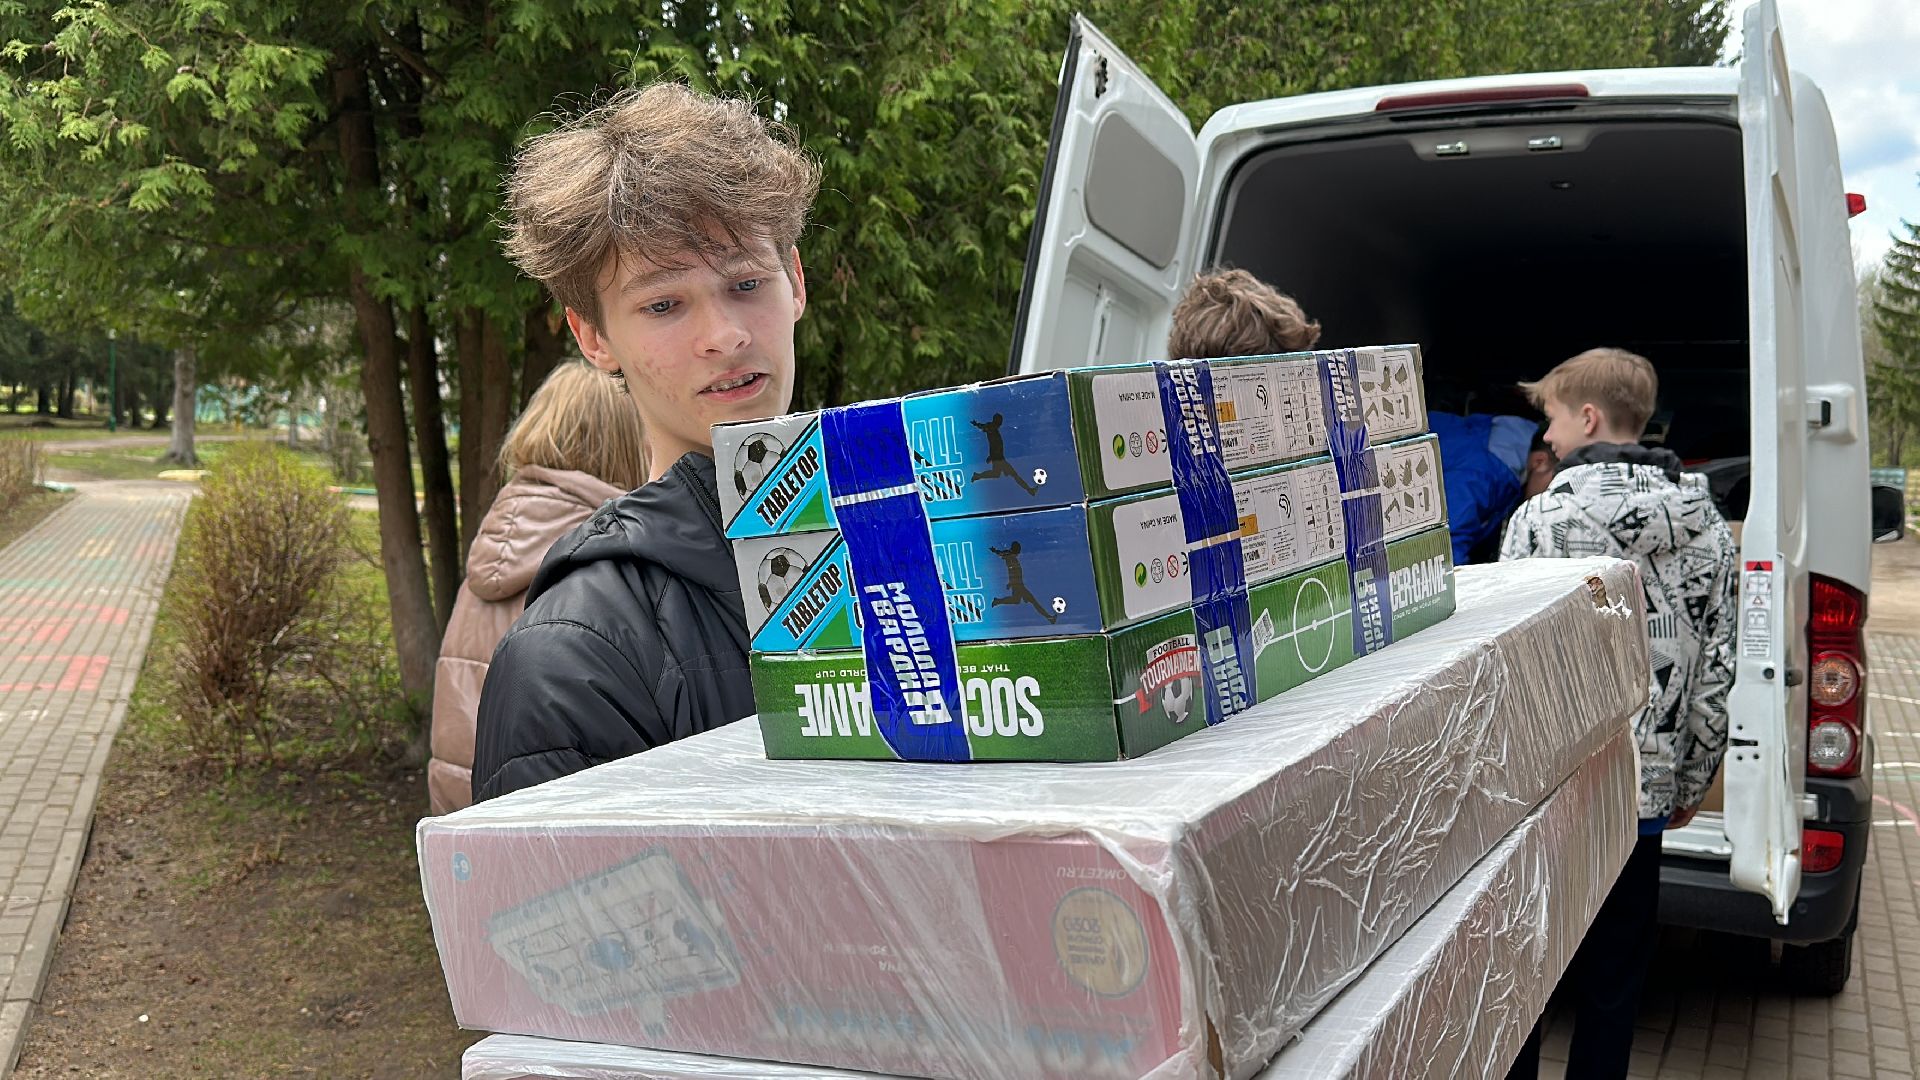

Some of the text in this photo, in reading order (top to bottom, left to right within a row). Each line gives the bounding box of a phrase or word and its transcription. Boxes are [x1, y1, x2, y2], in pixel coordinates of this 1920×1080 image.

[756, 445, 820, 527] TABLETOP
[1389, 554, 1448, 612] CERGAME
[781, 562, 843, 640] TABLETOP
[1153, 637, 1190, 658] FOOTBALL
[816, 670, 836, 678] CUP
[840, 669, 867, 677] ORLD
[981, 664, 1010, 673] THAT
[1140, 650, 1201, 695] TOURNAMEN
